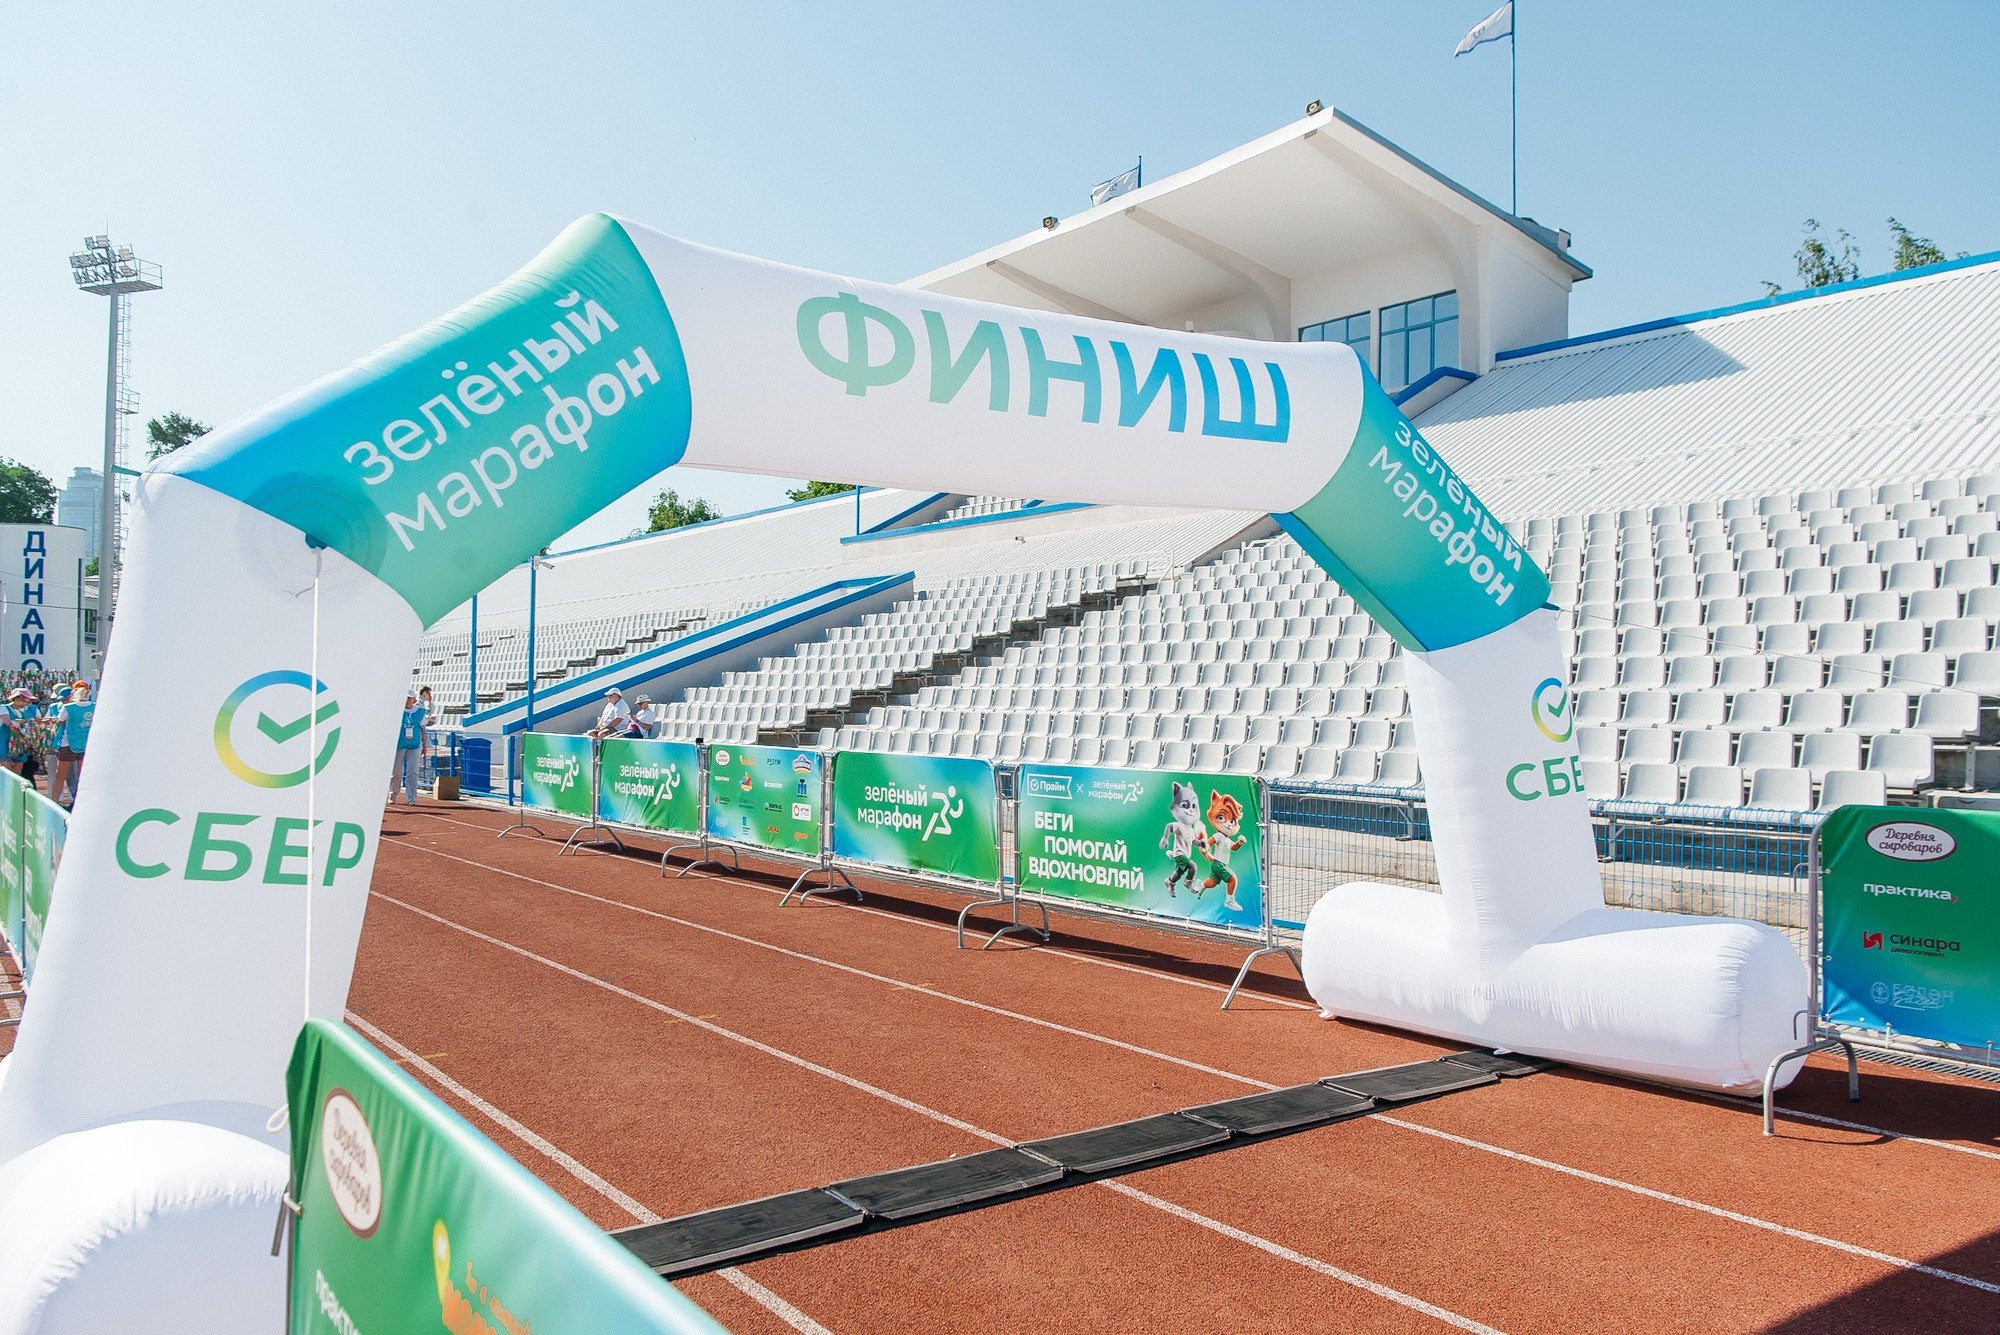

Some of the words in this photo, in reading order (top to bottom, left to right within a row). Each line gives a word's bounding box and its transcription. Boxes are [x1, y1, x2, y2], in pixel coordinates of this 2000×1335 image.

[796, 292, 1291, 443] ФИНИШ
[343, 290, 620, 485] зелёный
[385, 346, 661, 552] марафон
[1394, 420, 1523, 572] зелёный
[1368, 445, 1515, 606] марафон
[536, 754, 565, 770] зелёный
[619, 761, 659, 780] зелёный
[533, 768, 562, 787] марафон
[615, 779, 655, 799] марафон
[1040, 780, 1066, 793] Прайм
[1092, 779, 1127, 790] зелёный
[1505, 755, 1585, 801] СБЕ
[864, 781, 928, 807] зелёный
[1088, 790, 1124, 801] марафон
[857, 805, 922, 832] марафон
[1034, 811, 1073, 833] БЕГИ
[1885, 827, 1937, 843] Деревня
[115, 808, 366, 887] СБЕР
[1044, 835, 1128, 864] ПОМОГАЙ
[1879, 840, 1943, 856] сыроваров
[1028, 856, 1145, 891] ВДОХНОВЛЯЙ
[1889, 933, 1961, 953] синара
